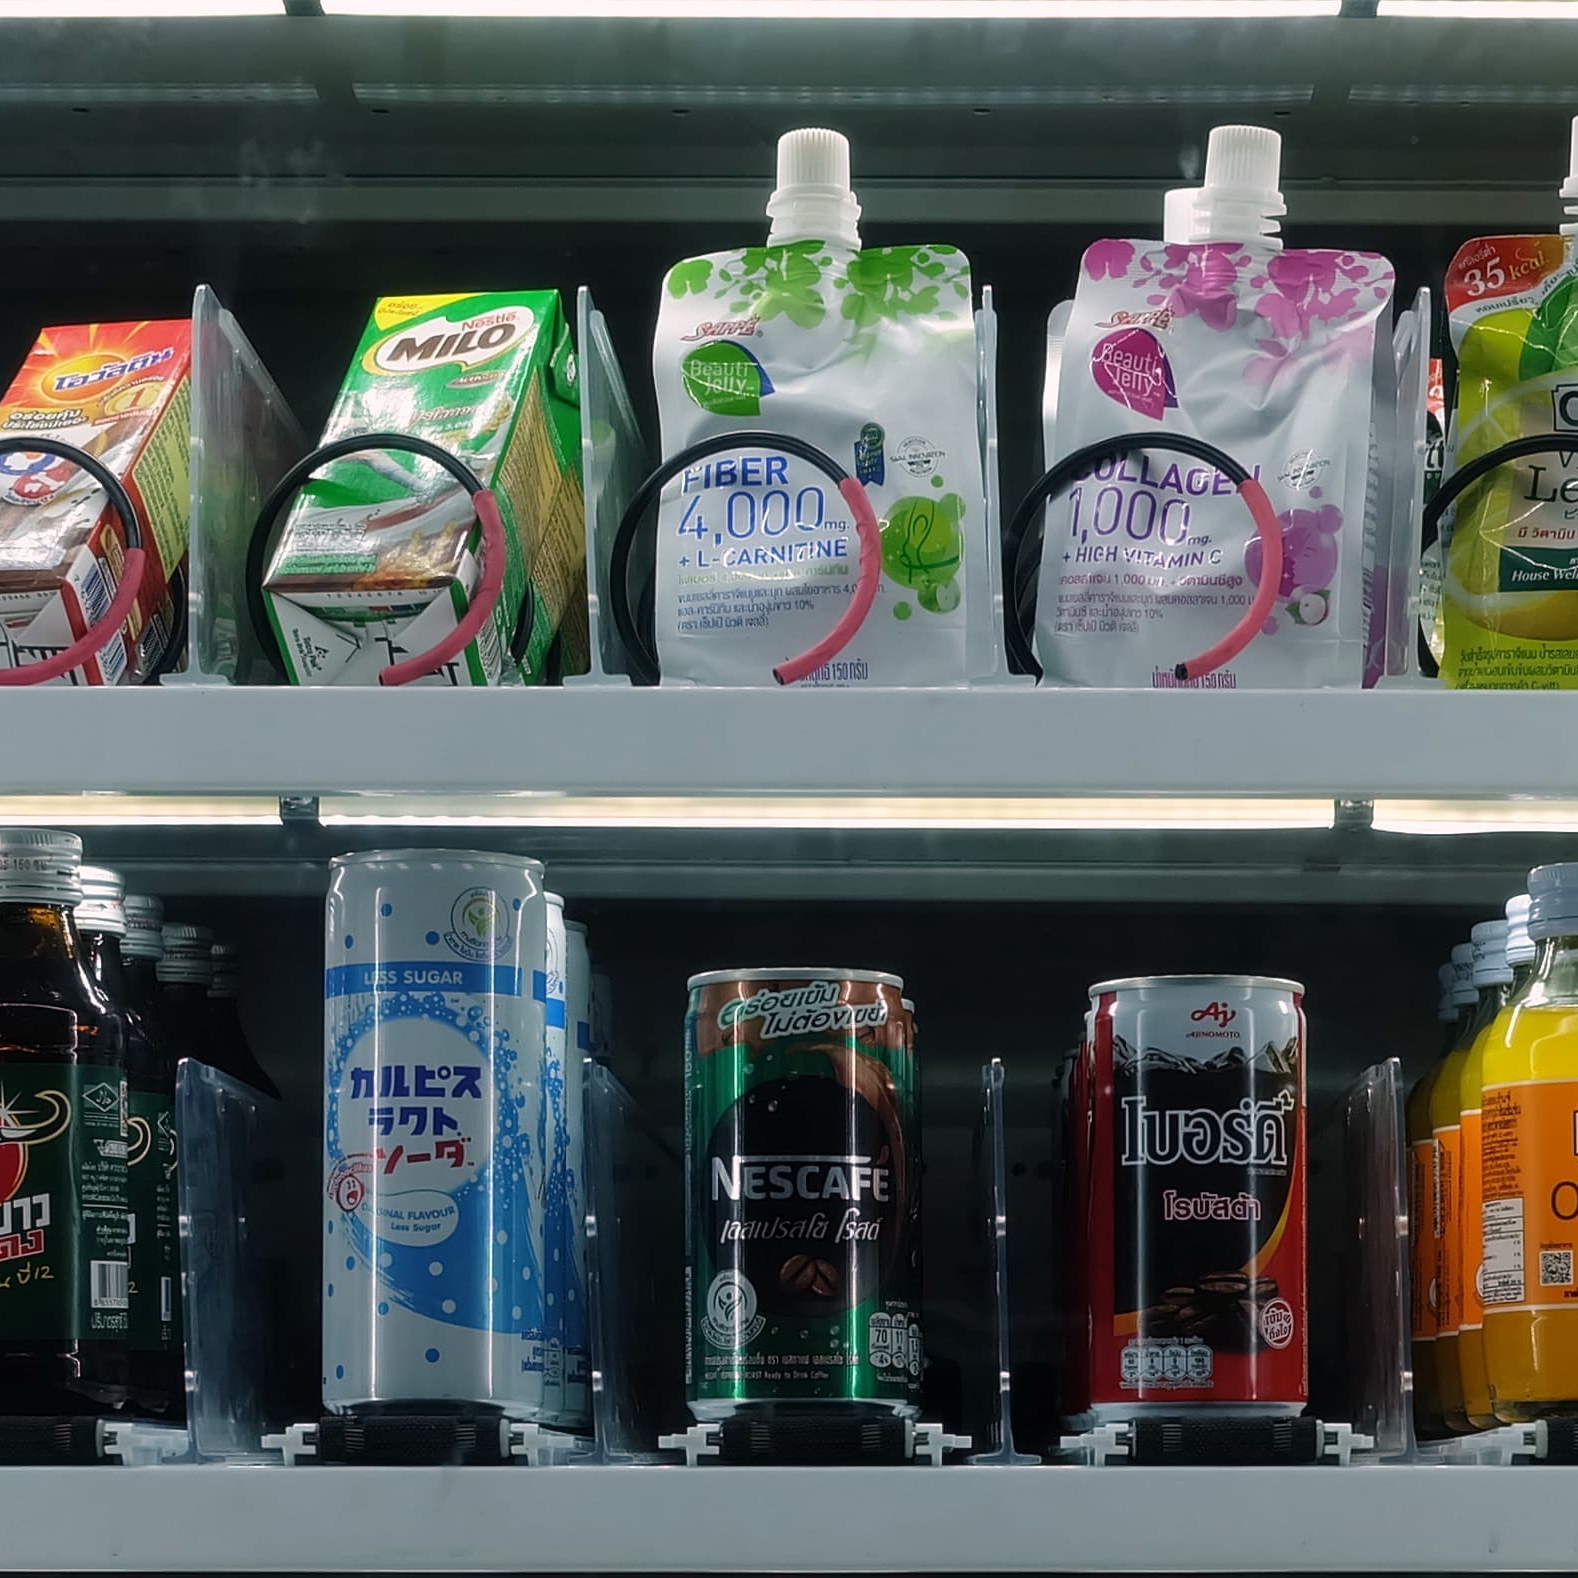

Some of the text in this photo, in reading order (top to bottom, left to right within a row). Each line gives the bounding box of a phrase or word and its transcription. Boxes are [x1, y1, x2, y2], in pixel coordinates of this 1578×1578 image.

[1462, 257, 1506, 297] 35
[386, 322, 516, 364] MILO
[54, 346, 174, 392] โอวัลติน
[689, 359, 748, 377] Beauti
[1102, 343, 1162, 375] Beauti
[684, 455, 789, 493] FIBER
[678, 487, 825, 547] 4,000
[1070, 486, 1192, 546] 1,000
[1531, 524, 1575, 540] วิตามิน
[698, 539, 848, 568] L-CARNITINE
[1076, 546, 1204, 569] HIGH VITAMIN
[1511, 569, 1550, 583] House
[832, 662, 850, 681] 150
[364, 970, 463, 985] LESS SUGAR
[1186, 1031, 1241, 1039] AJINOMOTO
[351, 1065, 482, 1099] カルピス
[368, 1107, 458, 1137] ラクト
[1122, 1089, 1294, 1166] เบอร์ดี้
[378, 1137, 475, 1174] ソーダ
[407, 1206, 456, 1221] FLAVOUR
[1163, 1189, 1262, 1221] โรบัสต้า
[413, 1222, 442, 1234] Sugar
[875, 1330, 888, 1344] 70
